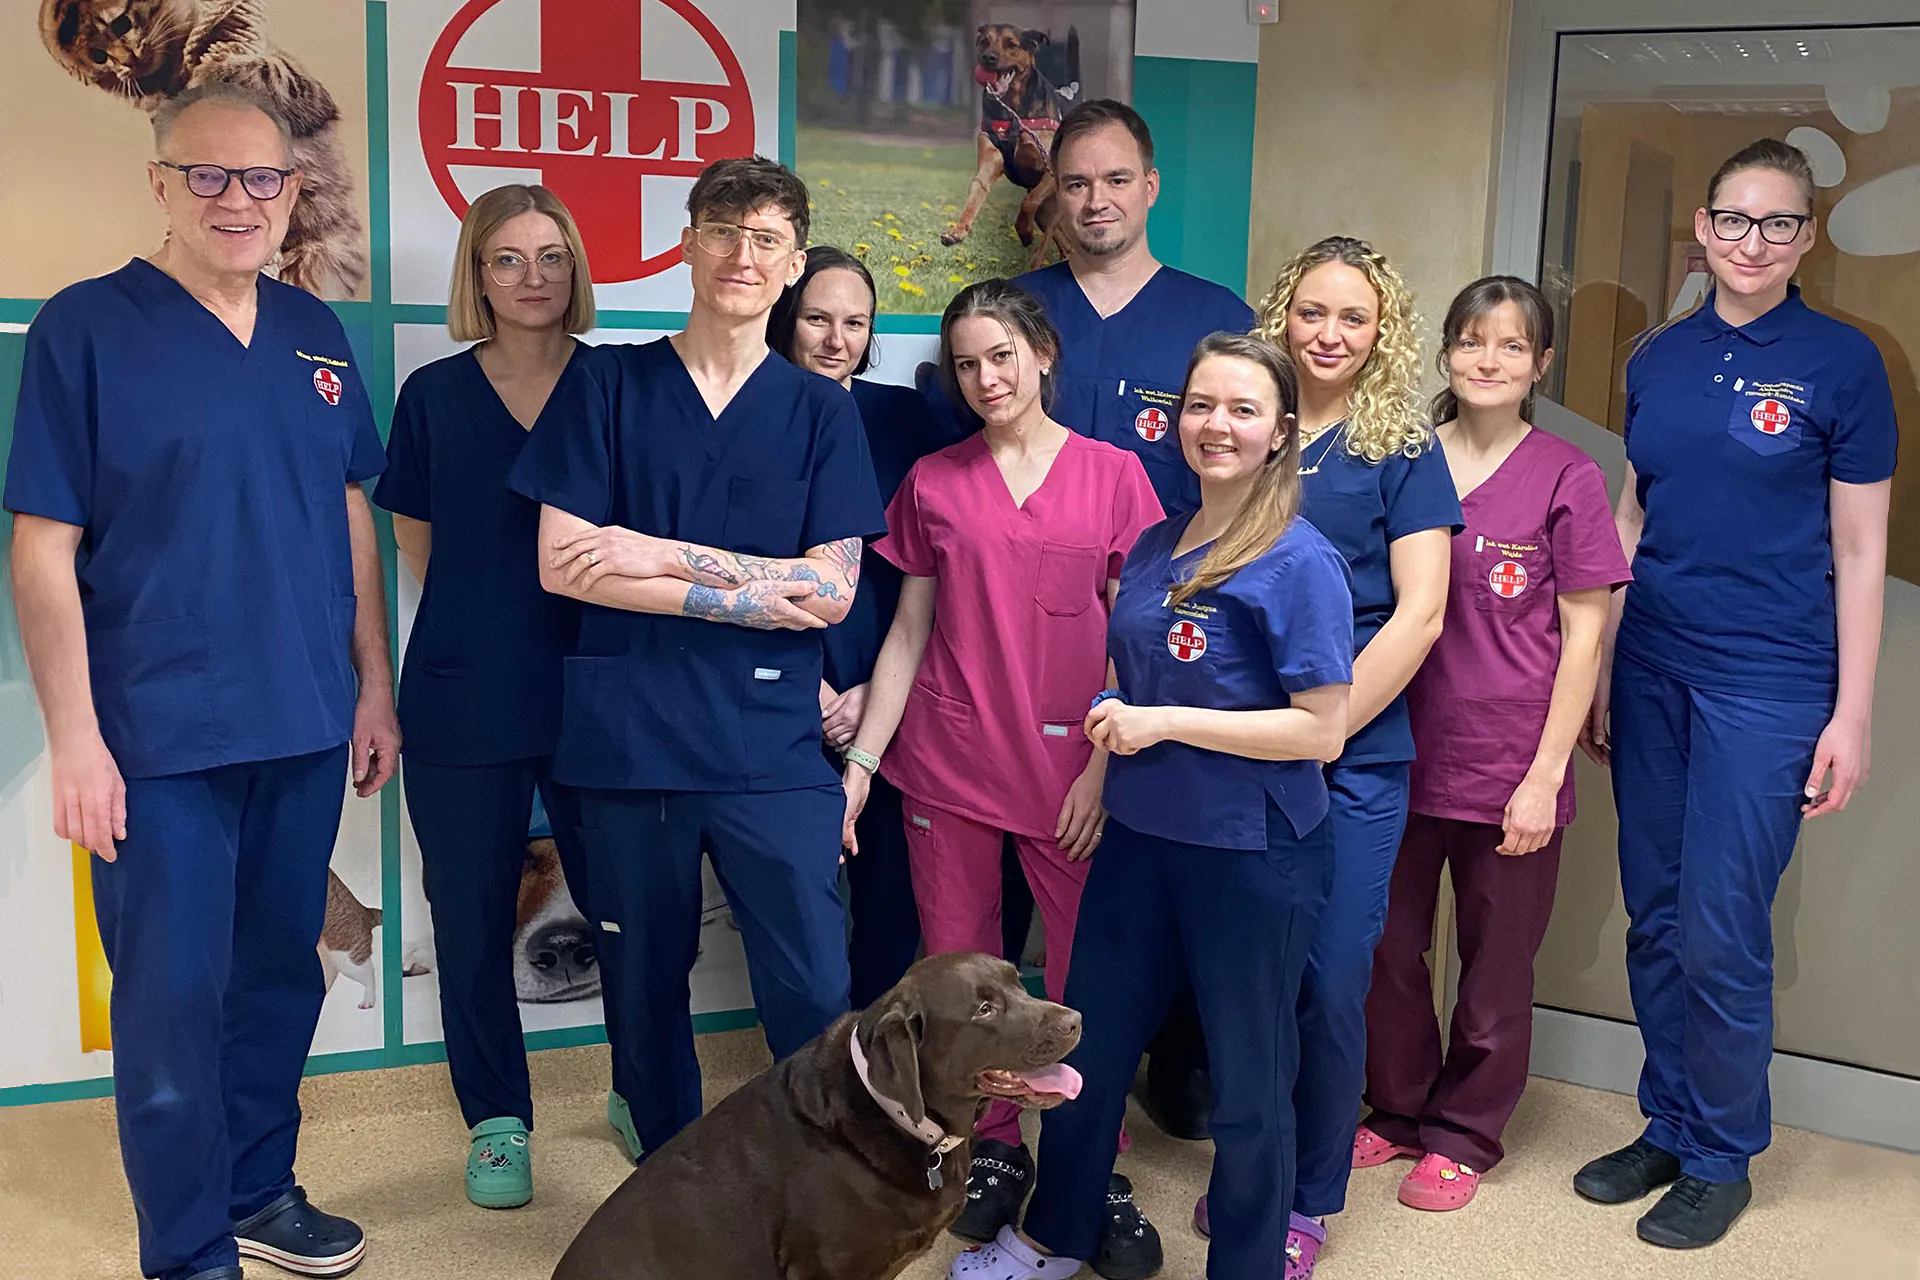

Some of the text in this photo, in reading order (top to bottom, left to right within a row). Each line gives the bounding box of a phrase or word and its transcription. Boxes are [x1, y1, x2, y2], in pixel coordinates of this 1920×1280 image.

[446, 81, 730, 162] HELP
[316, 379, 340, 394] HELP
[1753, 410, 1787, 423] HELP
[1138, 419, 1166, 430] HELP
[1493, 573, 1524, 584] HELP
[1170, 633, 1203, 648] HELP
